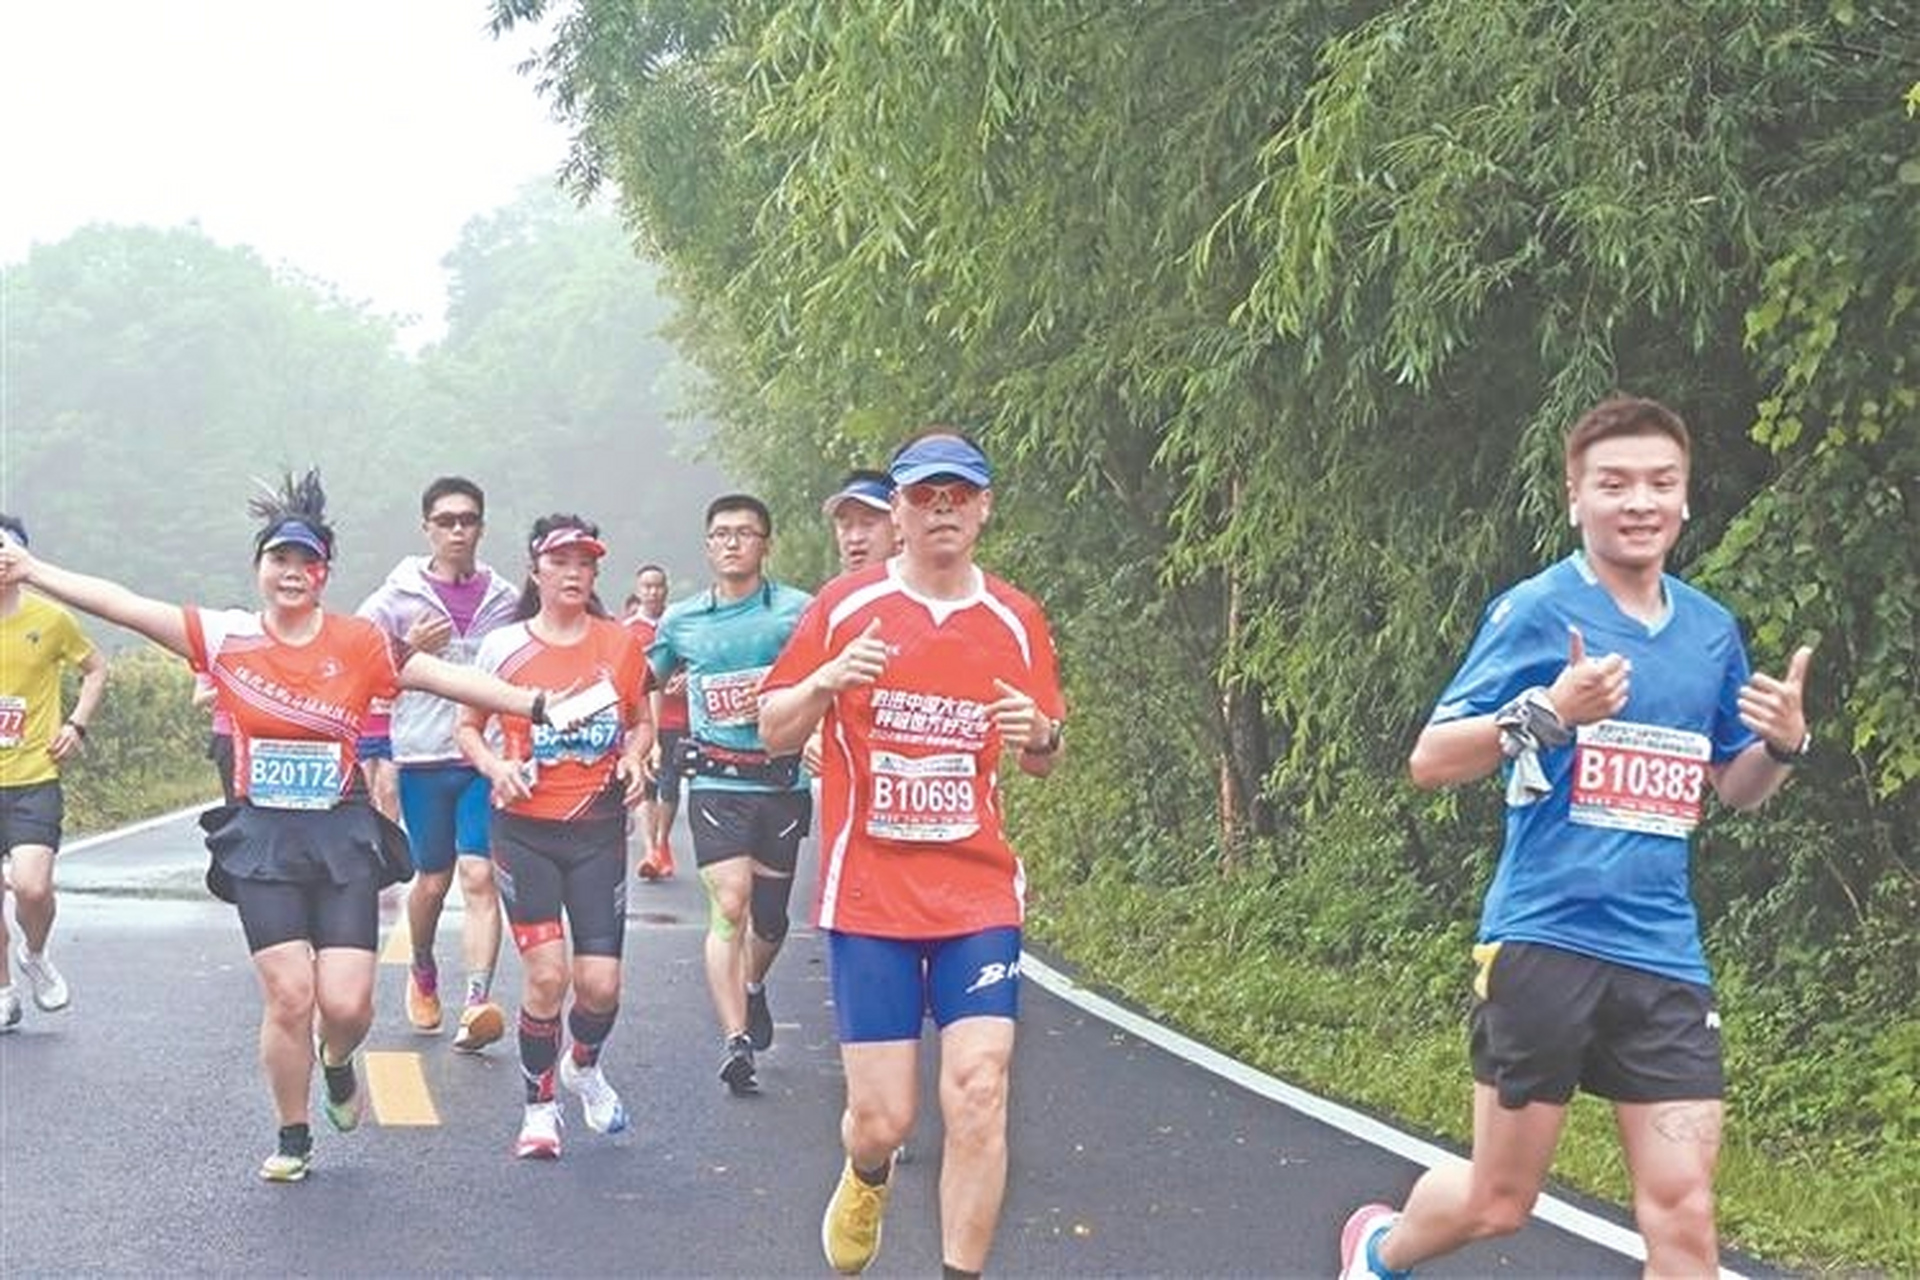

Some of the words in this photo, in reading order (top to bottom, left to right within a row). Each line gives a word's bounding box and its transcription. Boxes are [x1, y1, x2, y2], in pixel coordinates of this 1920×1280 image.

[251, 759, 337, 787] B20172
[1579, 749, 1704, 803] B10383
[875, 776, 974, 812] B10699
